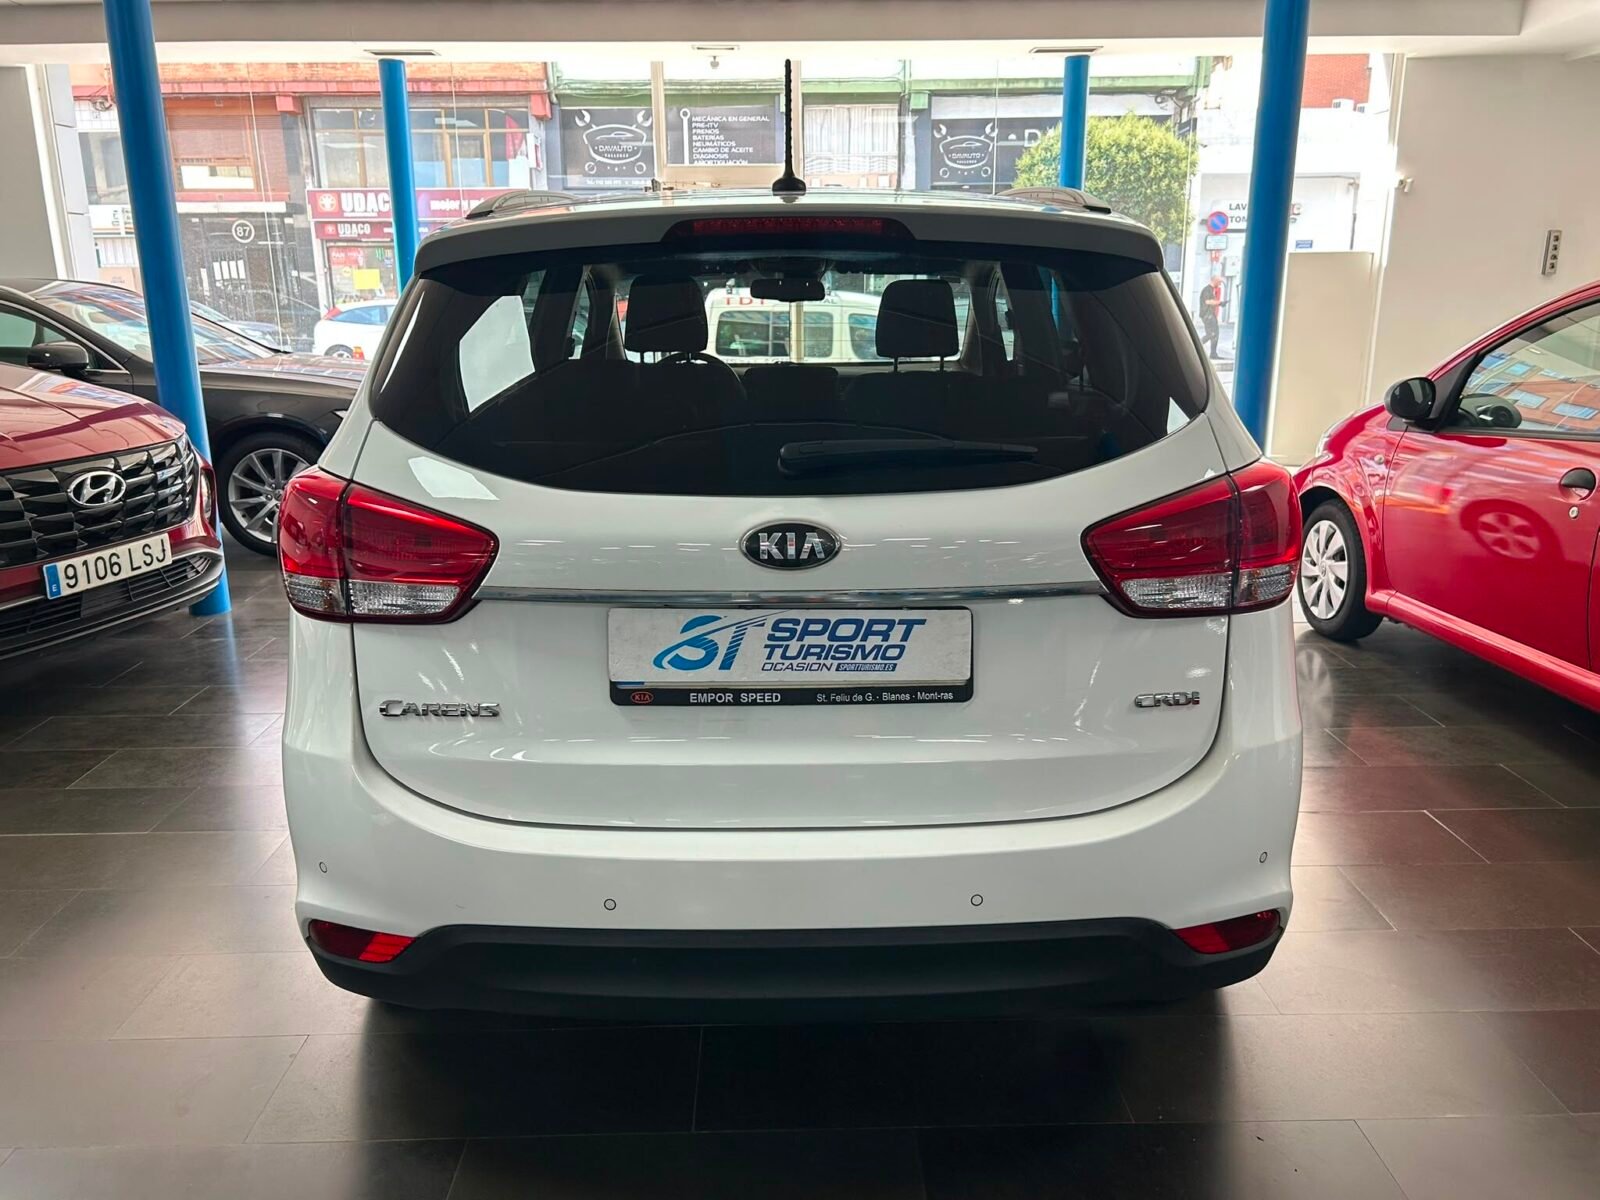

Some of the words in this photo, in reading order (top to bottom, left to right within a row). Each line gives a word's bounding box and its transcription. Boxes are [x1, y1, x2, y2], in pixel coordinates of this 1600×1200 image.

[1229, 203, 1247, 211] LAV
[236, 226, 250, 237] 87
[338, 223, 370, 235] UDACO
[759, 532, 825, 559] KIA
[64, 552, 122, 589] 9106
[128, 538, 167, 571] LSJ
[52, 584, 58, 592] E
[767, 618, 927, 642] SPORT
[763, 644, 906, 661] TURISMO
[761, 662, 833, 672] OCASION
[838, 663, 893, 671] SPORTTURISMO.ES
[634, 692, 650, 700] KIA
[690, 693, 733, 703] EMPOR
[740, 693, 781, 703] SPEED
[816, 693, 828, 702] St.
[830, 693, 850, 702] Feliu
[852, 693, 863, 702] de
[865, 692, 875, 702] G.
[882, 692, 910, 701] Blanes
[917, 691, 954, 700] Mont-ras
